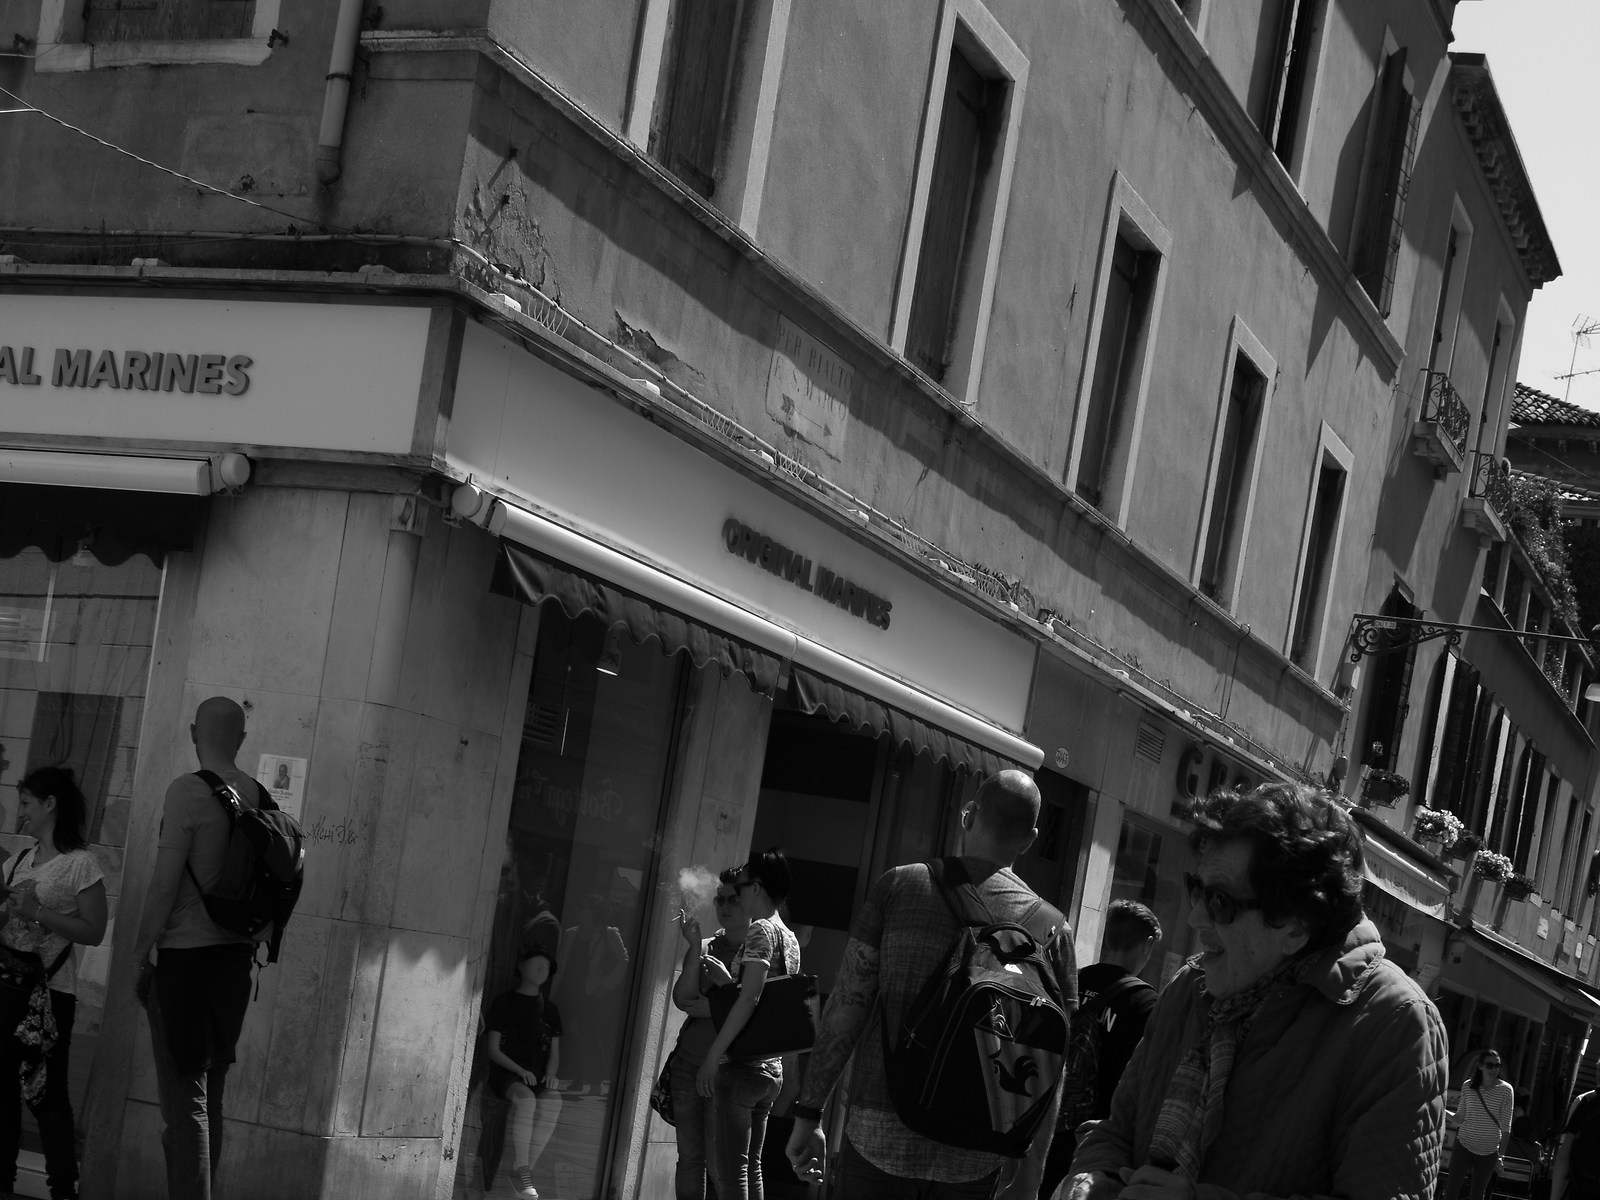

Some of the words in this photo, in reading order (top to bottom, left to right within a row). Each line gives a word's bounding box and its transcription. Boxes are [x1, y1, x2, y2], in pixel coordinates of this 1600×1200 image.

[51, 348, 254, 396] MARINES
[777, 322, 802, 358] PER
[808, 346, 853, 394] RIALTO
[721, 518, 813, 592] ORIGINAL
[813, 565, 893, 631] MARINES
